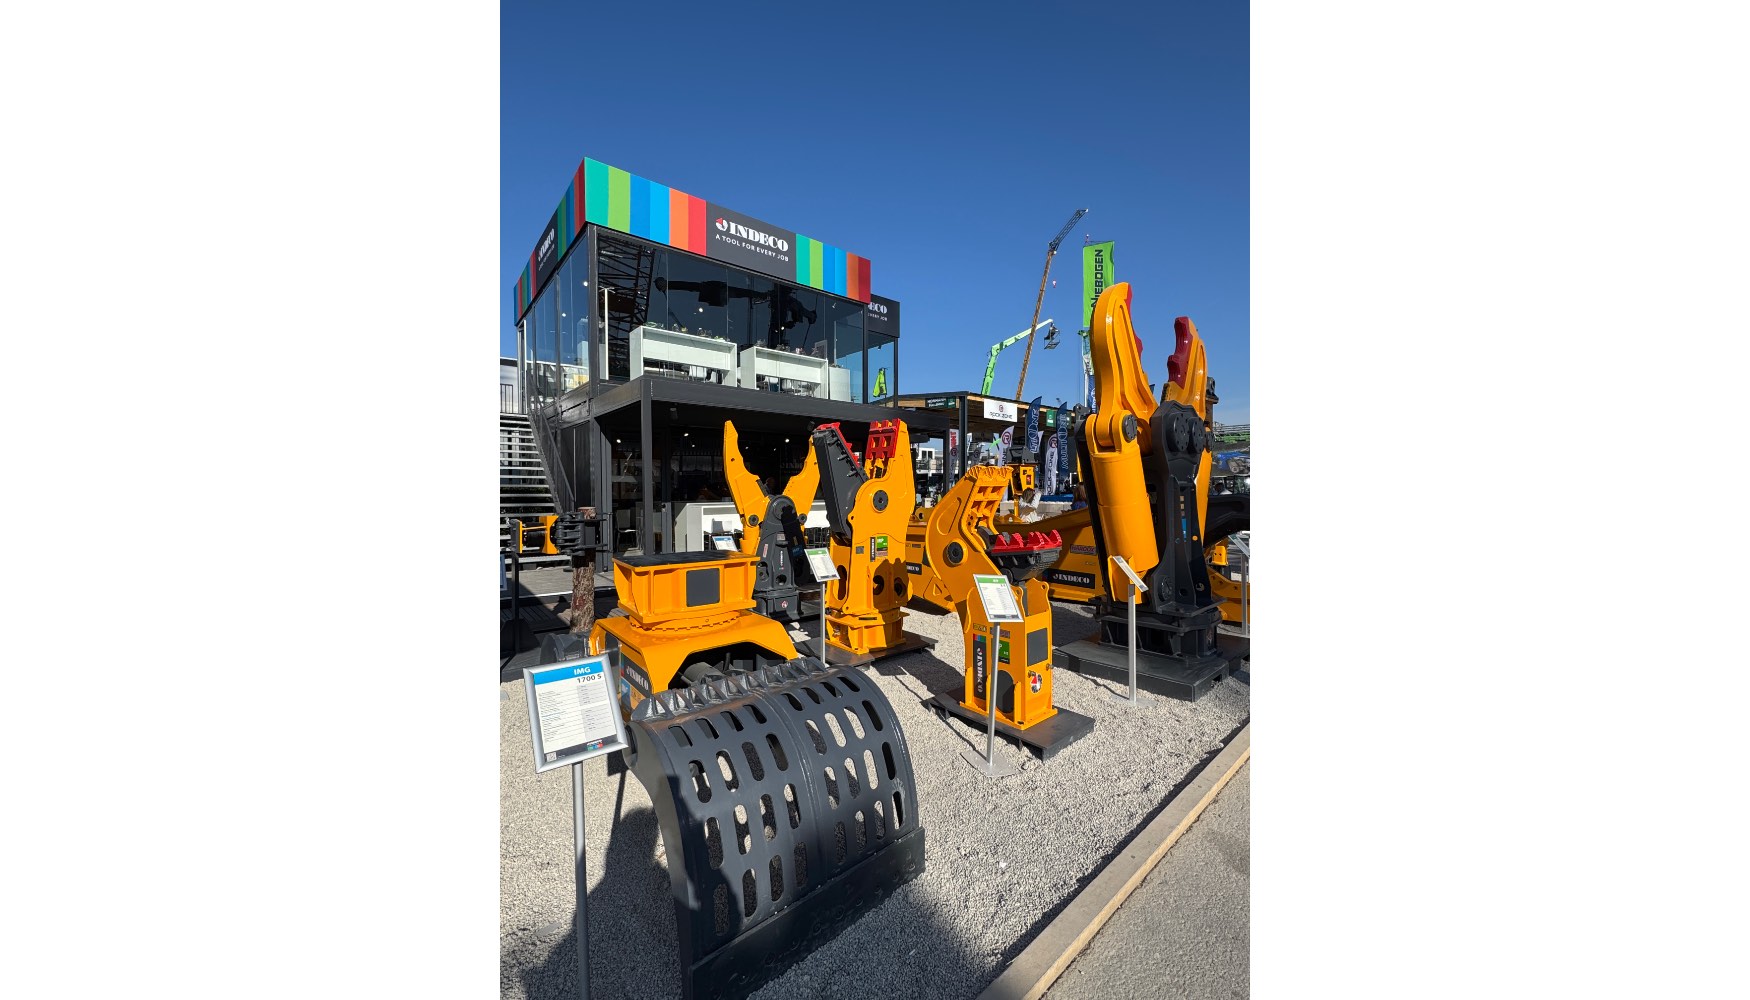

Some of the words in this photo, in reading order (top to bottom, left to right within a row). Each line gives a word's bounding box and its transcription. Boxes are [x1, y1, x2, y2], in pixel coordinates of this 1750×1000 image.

[729, 222, 788, 251] INDECO
[722, 235, 740, 247] TOOL
[742, 242, 755, 251] FOR
[757, 247, 776, 258] EVERY
[777, 254, 789, 262] JOB
[1058, 573, 1090, 584] INDECO
[573, 666, 591, 675] IMG
[577, 675, 596, 683] 1700
